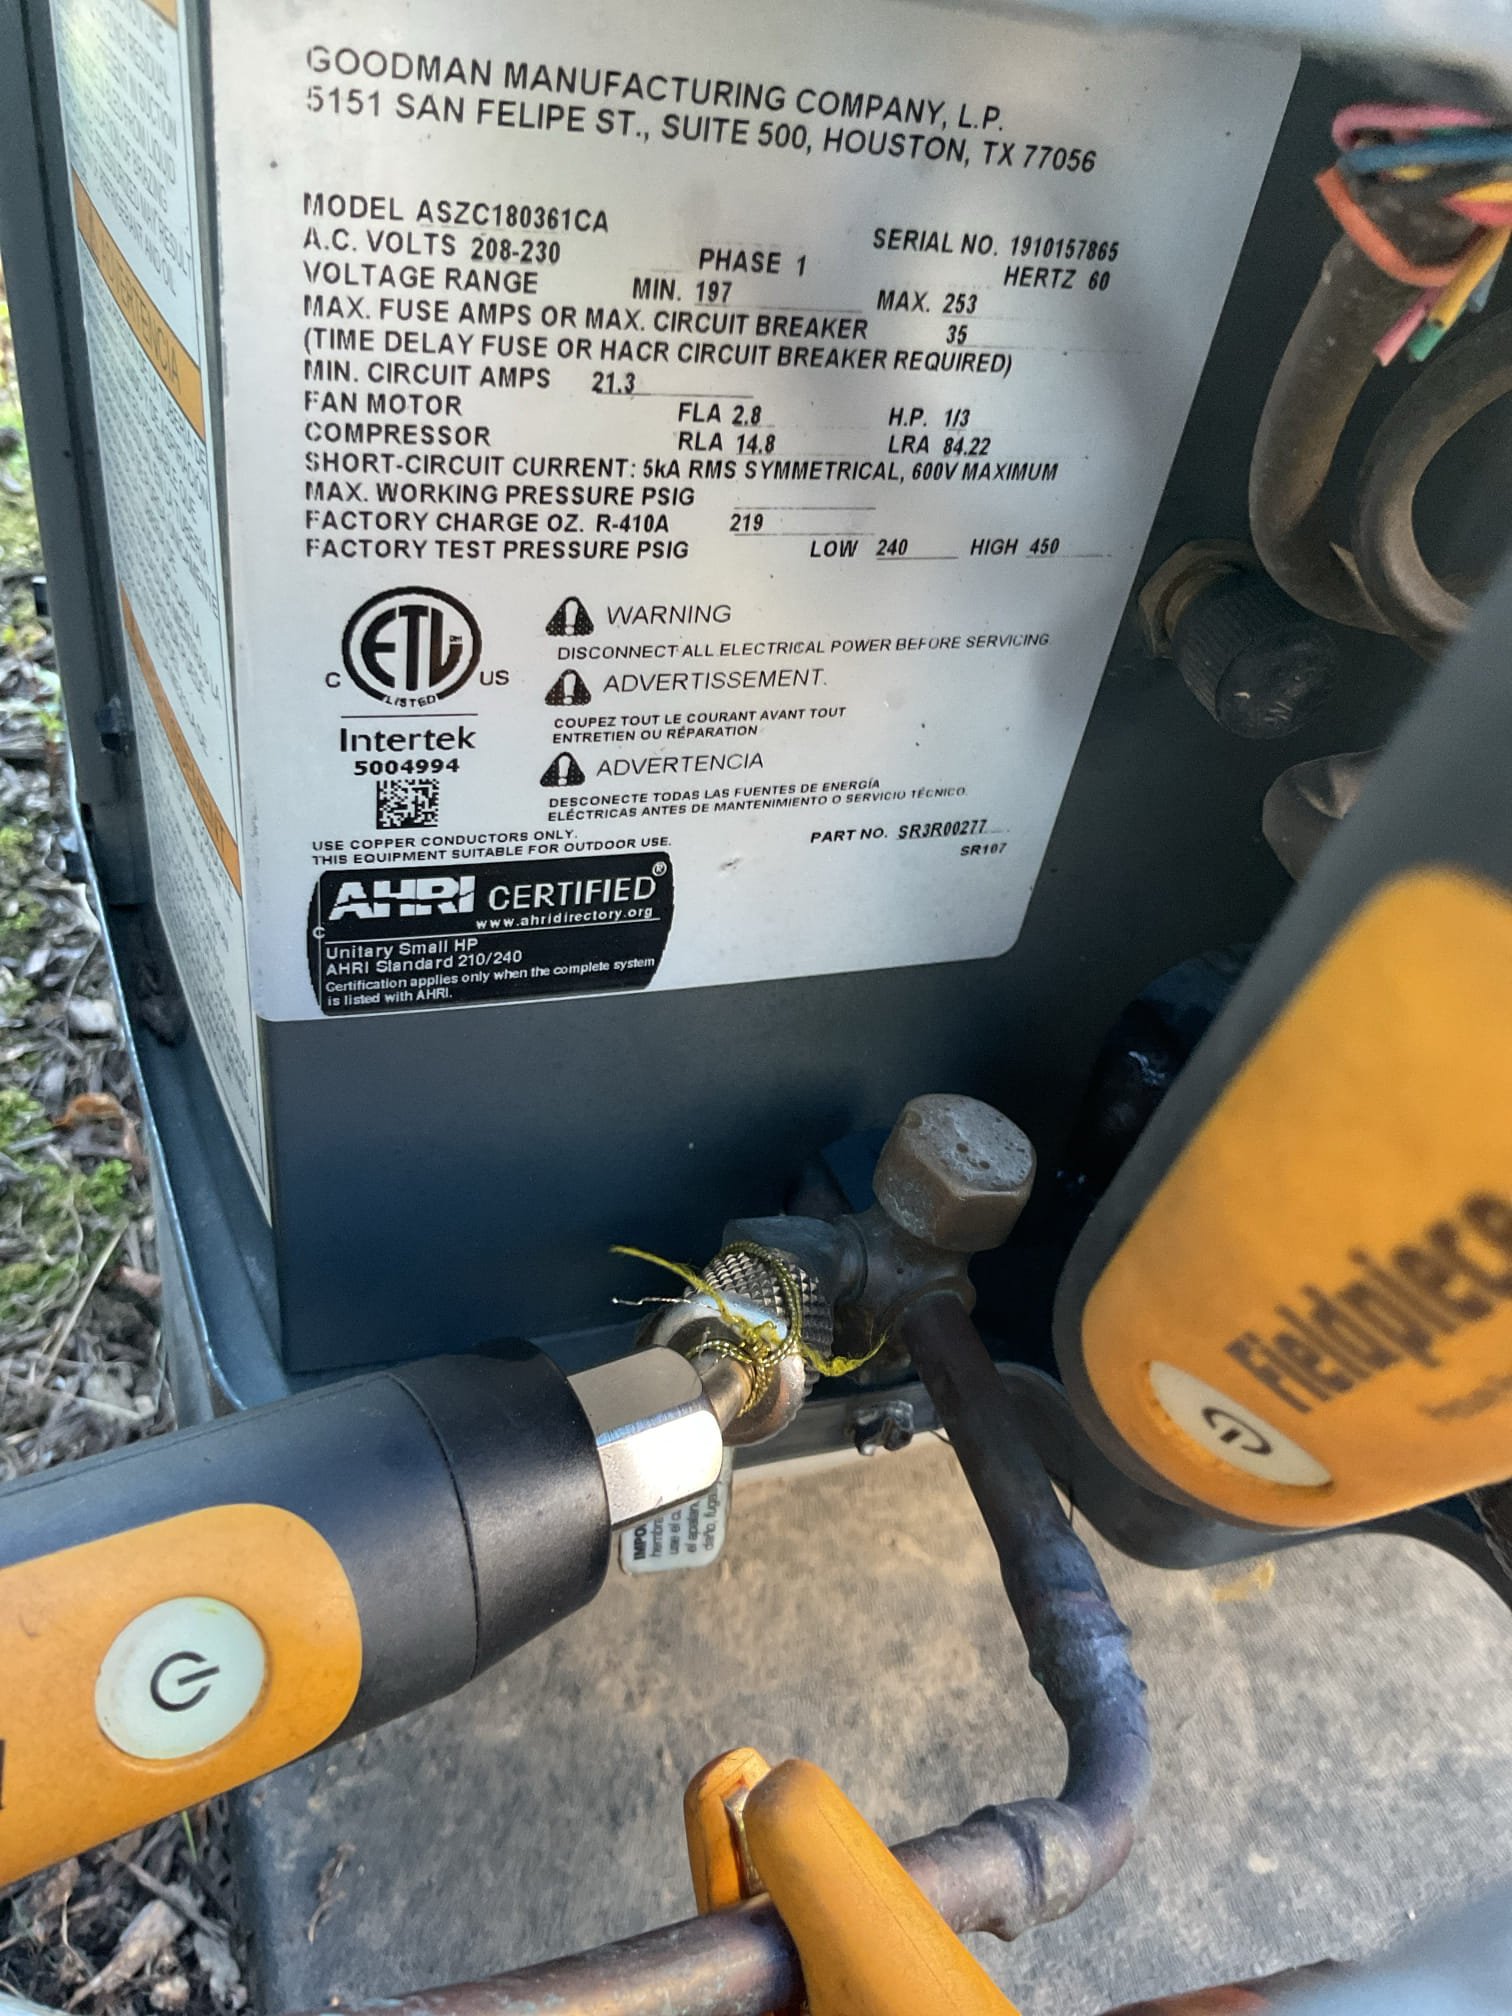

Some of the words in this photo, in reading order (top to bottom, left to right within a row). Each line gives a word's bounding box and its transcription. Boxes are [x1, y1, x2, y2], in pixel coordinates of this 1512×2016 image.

[307, 46, 492, 86] GOODMAN
[504, 62, 785, 111] MANUFACTURING
[796, 89, 948, 130] COMPANY,
[958, 104, 1003, 131] L.P.
[307, 86, 380, 117] 5151
[396, 93, 464, 123] SAN
[477, 100, 585, 132] FELIPE
[596, 109, 649, 143] ST.,
[662, 115, 748, 146] SUITE
[758, 122, 813, 155] 500,
[823, 128, 970, 166] HOUSTON,
[984, 141, 1013, 166] TX
[1023, 144, 1096, 173] 77056
[303, 193, 403, 221] MODEL
[417, 199, 608, 233] ASZC180361CA
[303, 226, 356, 252] A.C.
[367, 229, 456, 256] VOLTS
[471, 237, 560, 264] 208-230
[873, 228, 953, 254] SERIAL
[961, 234, 998, 256] NO.
[1011, 236, 1119, 262] 1910157865
[699, 248, 781, 274] PHASE
[797, 255, 806, 276] 1
[303, 261, 435, 288] VOLTAGE
[446, 269, 538, 293] RANGE
[1003, 266, 1074, 289] HERTZ
[1088, 270, 1110, 291] 60
[633, 277, 681, 302] MIN.
[696, 281, 732, 303] 197
[877, 290, 930, 312] MAX.
[942, 293, 978, 314] 253
[303, 295, 371, 320] MAX.
[380, 296, 449, 323] FUSE
[459, 302, 531, 327] AMPS
[541, 305, 578, 328] OR
[586, 307, 645, 331] MAX.
[654, 311, 749, 334] CIRCUIT
[755, 314, 868, 340] BREAKER
[946, 324, 967, 345] 35
[304, 328, 375, 354] (TIME
[384, 331, 474, 355] DELAY
[482, 334, 548, 359] FUSE
[557, 337, 592, 360] OR
[600, 340, 668, 362] HACR
[677, 341, 771, 366] CIRCUIT
[777, 346, 886, 370] BREAKER
[894, 351, 1012, 378] REQUIRED)
[304, 361, 358, 383] MIN.
[367, 362, 471, 387] CIRCUIT
[479, 367, 550, 388] AMPS
[591, 371, 635, 393] 21.3
[304, 391, 357, 413] FAN
[367, 394, 463, 416] MOTOR
[678, 402, 721, 423] FLA
[732, 405, 761, 425] 2.8
[889, 408, 927, 427] H.P.
[945, 409, 970, 427] 1/3
[304, 422, 491, 446] COMPRESSOR
[678, 431, 723, 452] RLA
[737, 434, 775, 455] 14.8
[889, 435, 929, 455] LRA
[943, 436, 991, 456] 84.22
[305, 452, 505, 477] SHORT-CIRCUIT
[512, 456, 636, 478] CURRENT:
[643, 459, 681, 479] 5kA
[689, 461, 736, 480] RMS
[744, 461, 906, 485] SYMMETRICAL,
[912, 462, 957, 480] 600V
[962, 463, 1058, 482] MAXIMUM
[305, 482, 369, 502] MAX.
[376, 483, 498, 504] WORKING
[506, 486, 634, 506] PRESSURE
[642, 487, 694, 506] PSIG
[305, 511, 428, 531] FACTORY
[436, 513, 538, 532] CHARGE
[547, 514, 584, 533] OZ.
[596, 515, 669, 533] R-410A
[730, 514, 763, 532] 219
[305, 539, 427, 559] FACTORY
[435, 540, 496, 559] TEST
[503, 541, 629, 559] PRESSURE
[637, 541, 689, 559] PSIG
[810, 541, 858, 558] LOW
[876, 539, 908, 556] 240
[970, 539, 1017, 556] HIGH
[1030, 538, 1060, 555] 450
[607, 605, 732, 625] WARNING
[558, 645, 678, 660] DISCONNECT
[682, 644, 713, 657] ALL
[719, 641, 825, 656] ELECTRICAL
[831, 639, 891, 652] POWER
[896, 636, 961, 650] BEFORE
[480, 670, 509, 685] US
[603, 668, 827, 692] ADVERTISSEMENT.
[386, 694, 436, 708] LISTED
[555, 717, 616, 728] COUPEZ
[621, 715, 660, 726] TOUT
[665, 714, 681, 725] LE
[687, 711, 756, 724] COURANT
[760, 709, 805, 721] AVANT
[811, 707, 846, 718] TOUT
[340, 726, 476, 752] Intertek
[354, 759, 459, 775] 5004994
[596, 753, 764, 777] ADVERTENCIA
[549, 793, 648, 808] DESCONECTE
[653, 790, 699, 801] TODAS
[705, 789, 729, 799] LAS
[734, 784, 796, 797] FUENTES
[800, 783, 817, 793] DE
[822, 778, 880, 791] ENERGÍA
[548, 807, 637, 821] ELÉCTRICAS
[641, 805, 686, 816] ANTES
[692, 803, 710, 813] DE
[714, 795, 827, 812] MANTENIMIENTO
[832, 794, 841, 805] O
[846, 790, 906, 803] SERVICIO
[312, 840, 344, 851] USE
[351, 837, 416, 850] COPPER
[421, 832, 528, 847] CONDUCTORS
[535, 830, 577, 841] ONLY.
[810, 830, 856, 843] PART
[860, 828, 887, 840] NO.
[898, 819, 987, 839] SR3R00277
[312, 855, 347, 865] THIS
[353, 850, 446, 864] EQUIPMENT
[452, 846, 523, 859] SUITABLE
[529, 843, 558, 855] FOR
[565, 839, 636, 853] OUTDOOR
[642, 837, 672, 848] USE.
[960, 843, 1007, 856] SR107
[329, 875, 476, 921] AHRI
[489, 876, 656, 911] CERTIFIED
[476, 907, 653, 930] www.ahridirectory.org
[326, 944, 393, 960] Unitary
[400, 941, 448, 956] Small
[455, 939, 478, 952] HP
[326, 963, 368, 976] AHRI
[376, 956, 453, 973] Standard
[458, 951, 522, 967] 210/240
[633, 1522, 646, 1560] IMPO
